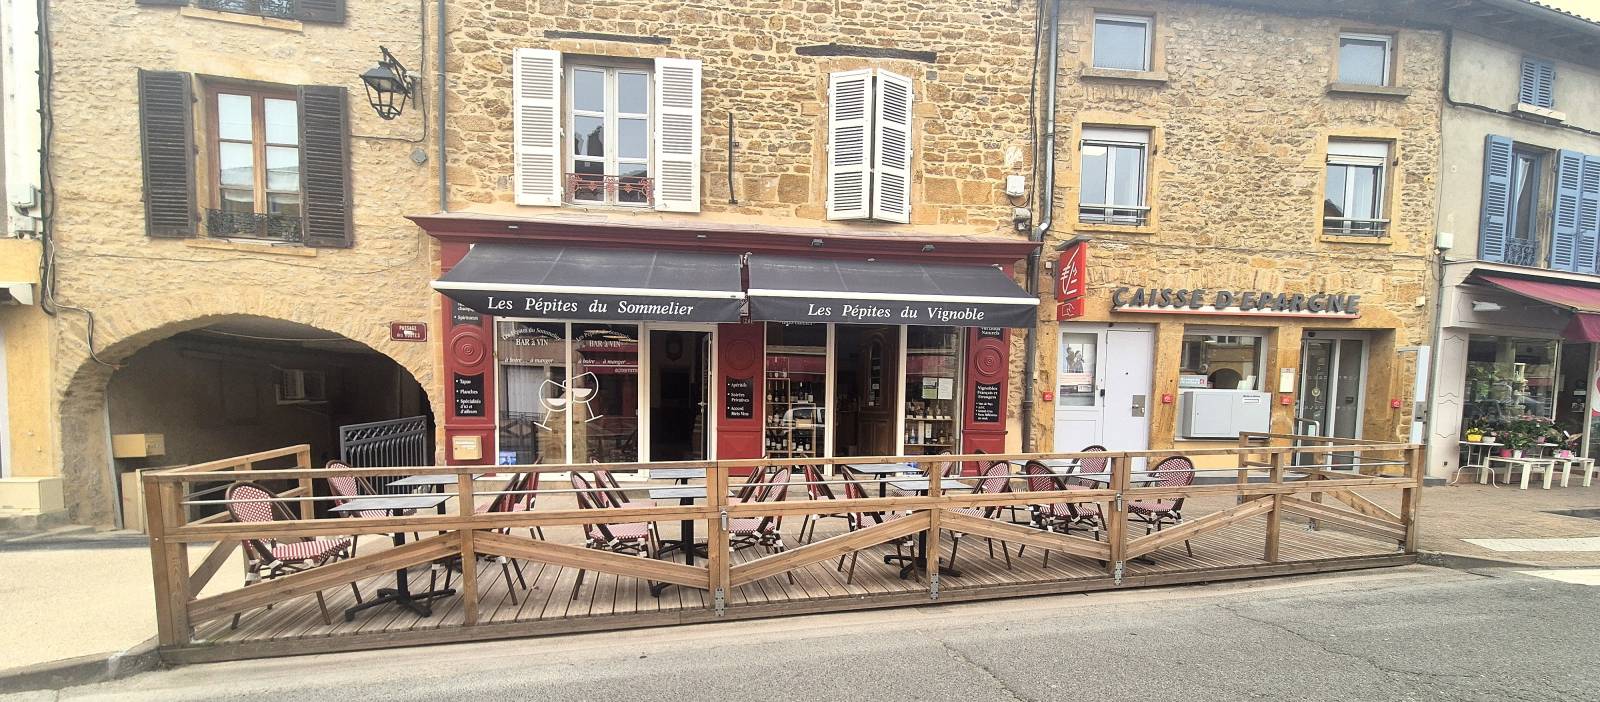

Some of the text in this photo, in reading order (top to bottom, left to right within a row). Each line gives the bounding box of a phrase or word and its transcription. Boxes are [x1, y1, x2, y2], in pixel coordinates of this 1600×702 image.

[487, 297, 694, 315] Les Pépites du Sommelier
[1112, 287, 1205, 310] CAISSE
[808, 303, 985, 322] Les Pépites du Vignoble
[515, 338, 530, 346] BAR
